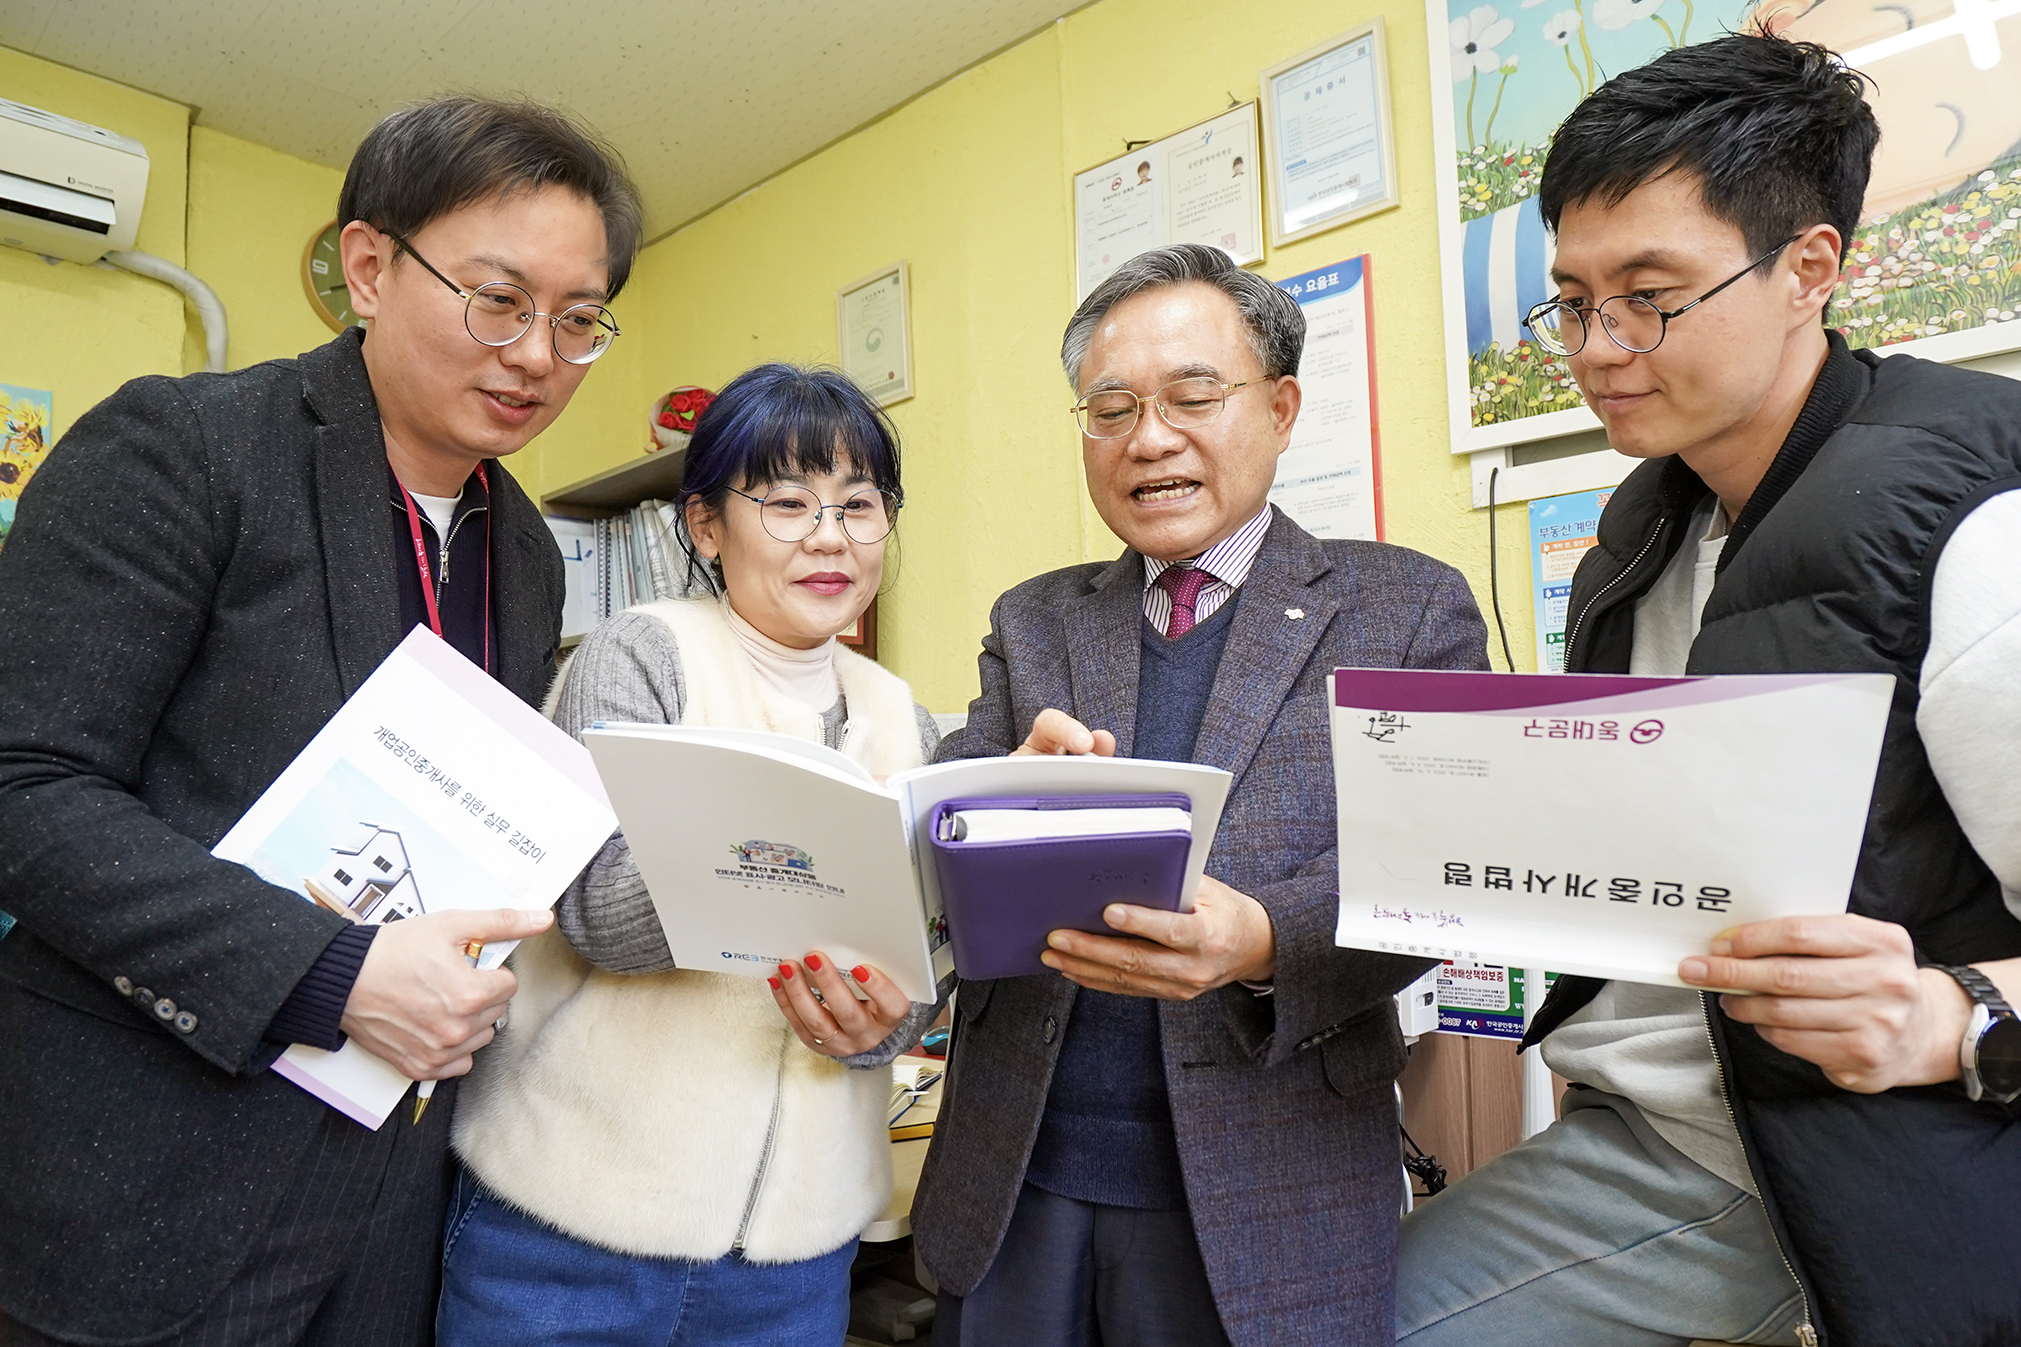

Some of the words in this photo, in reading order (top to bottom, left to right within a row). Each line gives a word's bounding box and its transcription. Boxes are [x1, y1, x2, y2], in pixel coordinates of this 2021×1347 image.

[1306, 272, 1340, 292] 요율표
[1538, 524, 1571, 539] 부동산
[1574, 519, 1598, 533] 계약
[1523, 718, 1620, 741] 동대문구
[373, 725, 462, 798] 개업공인중개사를
[460, 792, 487, 817] 위한
[483, 812, 511, 834] 실무
[508, 830, 547, 864] 길잡이
[1443, 861, 1732, 913] 공인중개사법령
[1443, 968, 1504, 982] 손해배상책임보증
